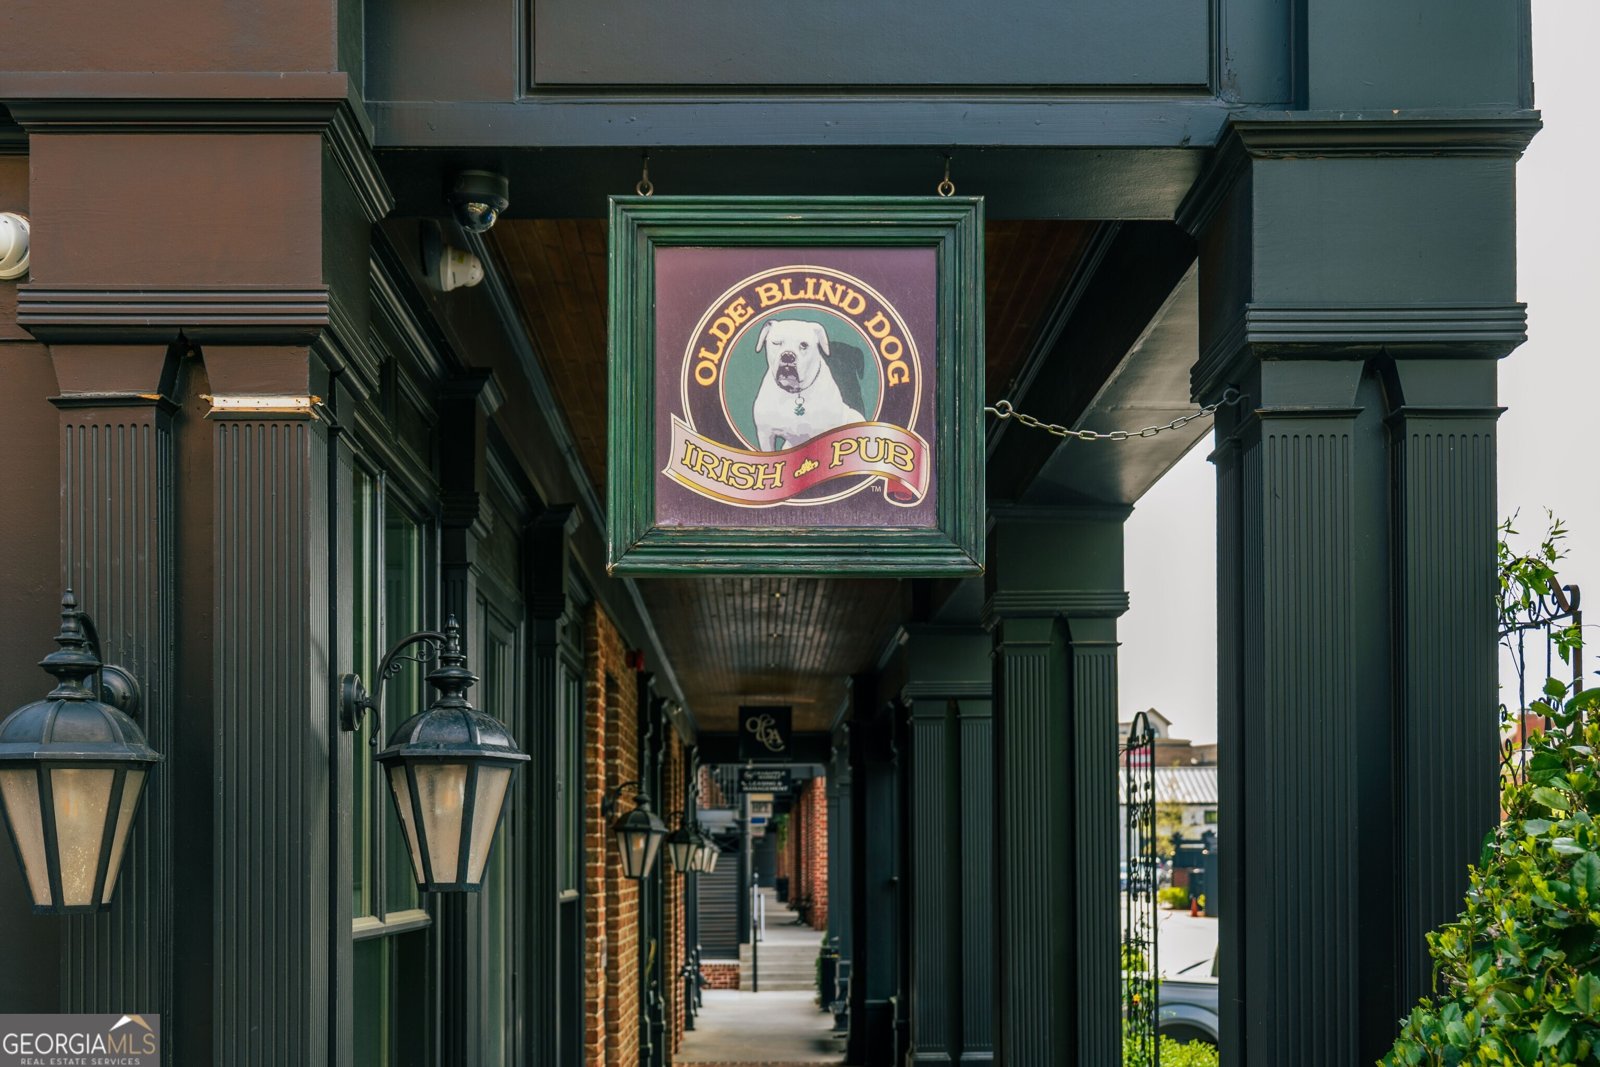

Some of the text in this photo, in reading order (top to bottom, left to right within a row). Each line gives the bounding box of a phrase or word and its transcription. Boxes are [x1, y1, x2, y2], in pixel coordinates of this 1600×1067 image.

[695, 277, 910, 387] OLDE BLIND DOG
[681, 436, 915, 490] IRISH PUB
